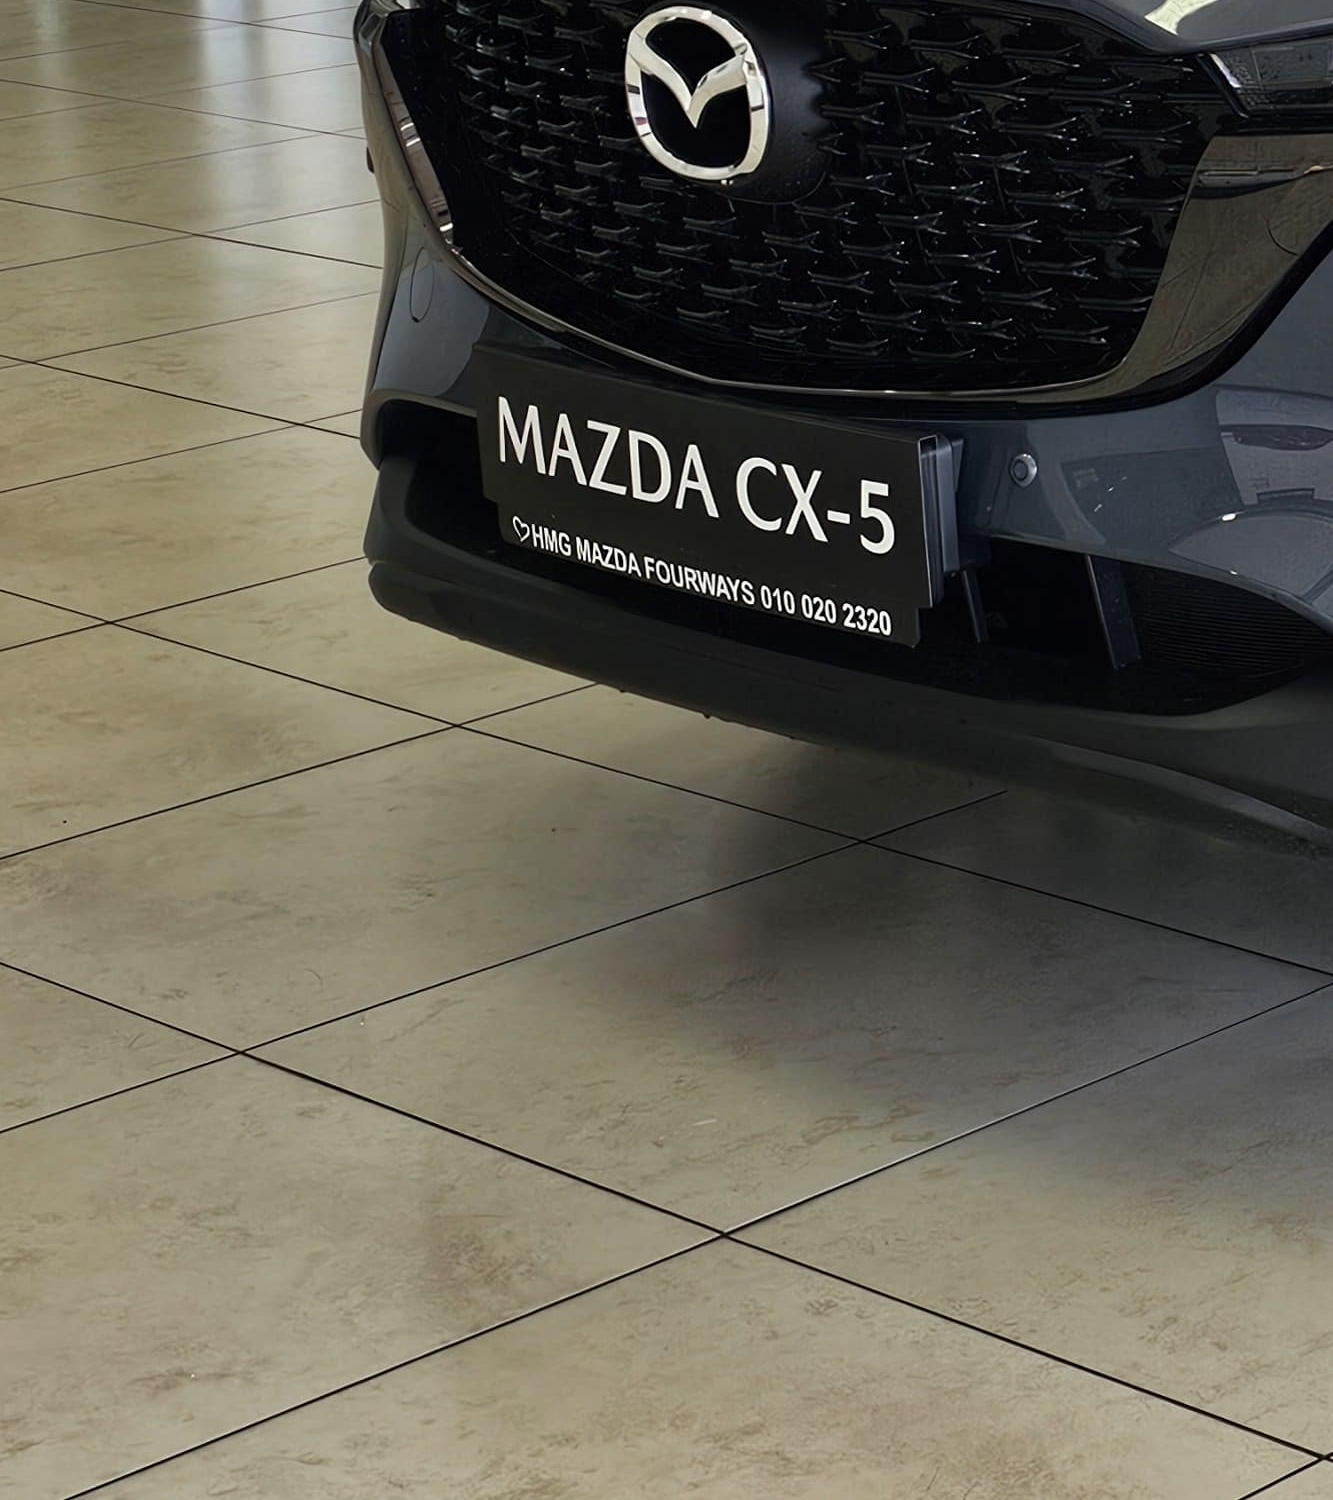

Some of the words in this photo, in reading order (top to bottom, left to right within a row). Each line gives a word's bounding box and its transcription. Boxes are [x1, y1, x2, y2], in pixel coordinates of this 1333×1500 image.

[498, 396, 720, 518] MAZDA
[735, 456, 896, 555] CX-5
[532, 523, 572, 558] HMG
[576, 536, 642, 579] MAZDA
[645, 556, 755, 606] FOURWAYS
[760, 584, 796, 616] 010
[801, 592, 837, 625] 020
[842, 602, 892, 637] 2320
